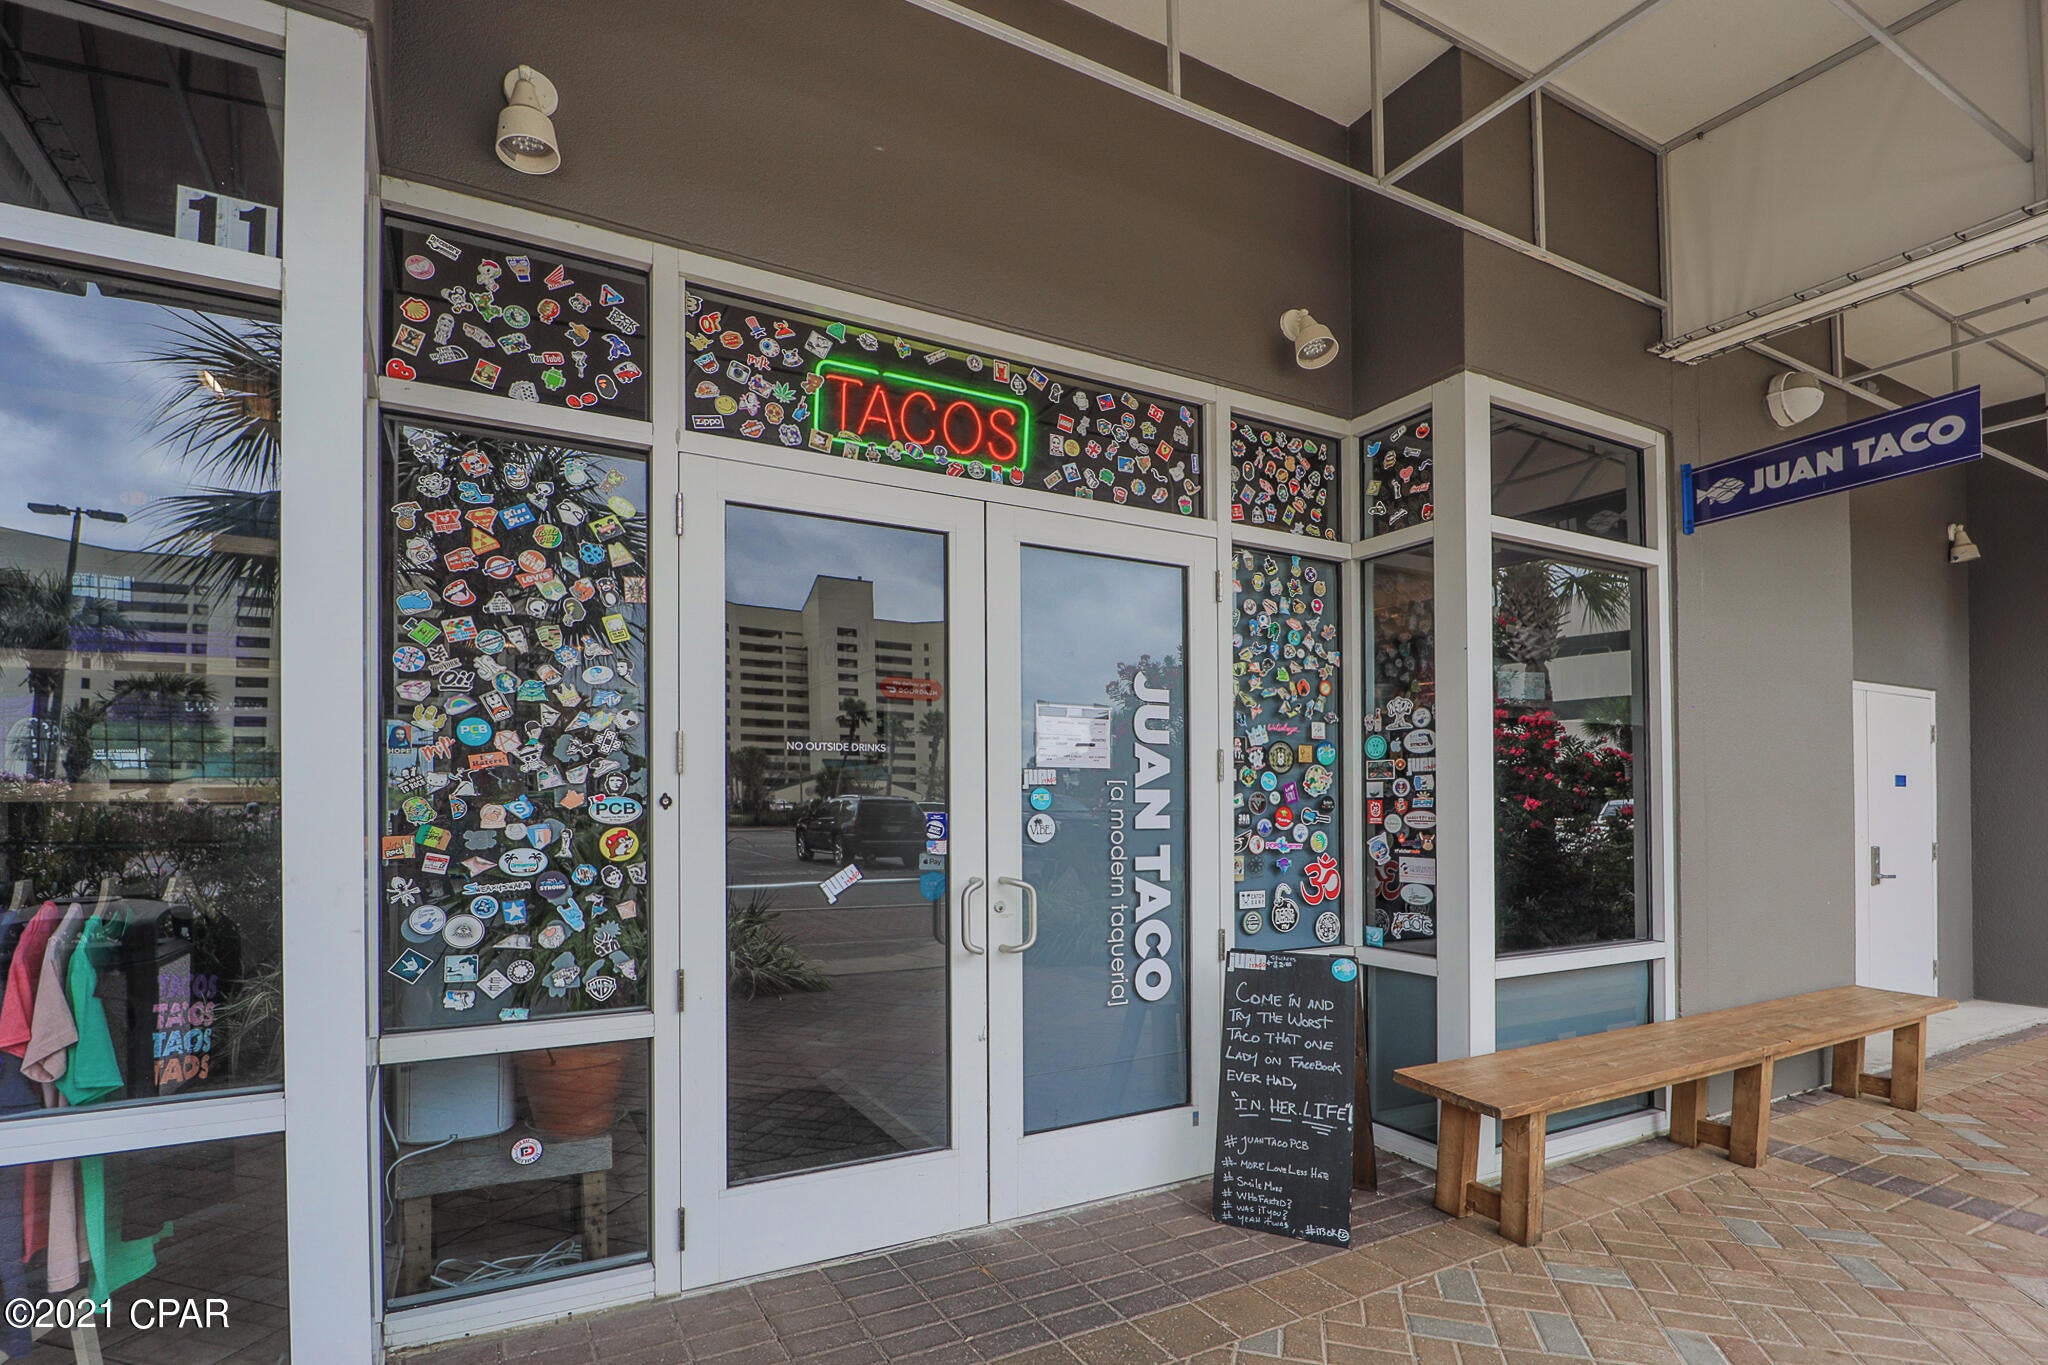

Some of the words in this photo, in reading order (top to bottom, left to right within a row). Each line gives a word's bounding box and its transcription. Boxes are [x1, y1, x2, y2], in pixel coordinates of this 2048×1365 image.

[188, 194, 268, 257] 11
[694, 417, 721, 429] zippo
[825, 373, 1018, 461] TACOS
[1748, 446, 1844, 494] JUAN
[1852, 415, 1967, 466] TACO
[460, 724, 489, 735] PCB
[787, 741, 804, 751] NO
[807, 741, 849, 752] OUTSIDE
[851, 743, 887, 753] DRINKS
[1133, 670, 1171, 829] JUAN
[595, 802, 636, 816] PCB
[1110, 808, 1129, 897] modern
[1134, 845, 1172, 1002] TACO
[1307, 1000, 1334, 1011] AND
[1257, 1011, 1283, 1024] THE
[1226, 1027, 1260, 1043] TACO
[1263, 1031, 1302, 1045] THAT
[1304, 1041, 1334, 1051] ONE
[1225, 1045, 1258, 1067] LADY
[1264, 1056, 1281, 1066] ON
[1226, 1069, 1261, 1083] EVER
